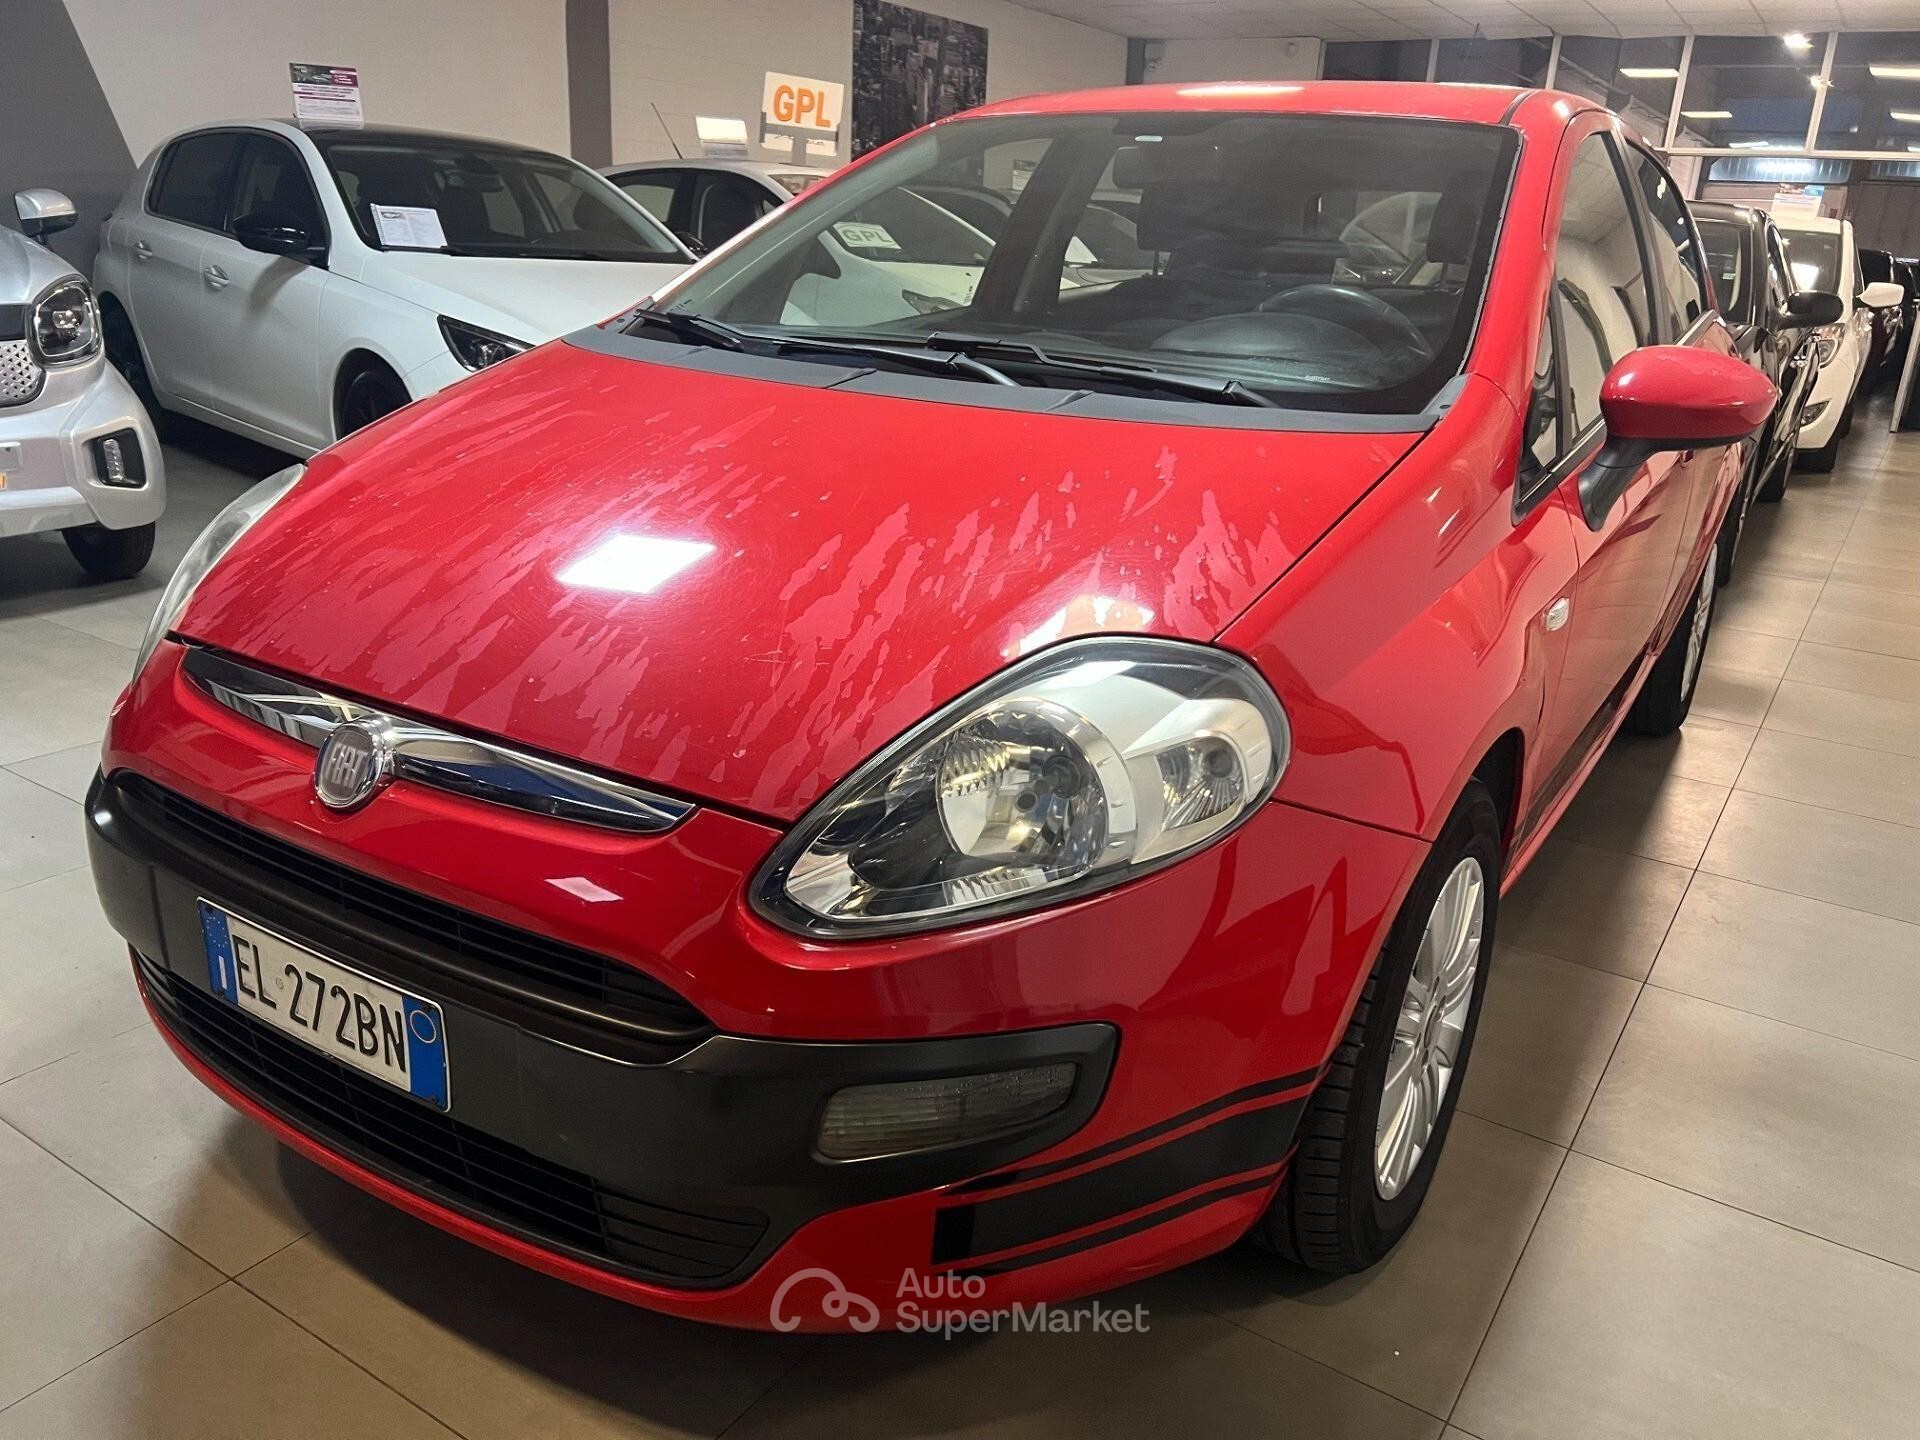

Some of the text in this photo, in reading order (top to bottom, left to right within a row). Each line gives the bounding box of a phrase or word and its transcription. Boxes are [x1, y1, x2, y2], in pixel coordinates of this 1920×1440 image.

[773, 84, 831, 128] GPL
[842, 229, 893, 243] GPL
[325, 741, 368, 789] FIAT
[232, 934, 406, 1073] EL 272BN
